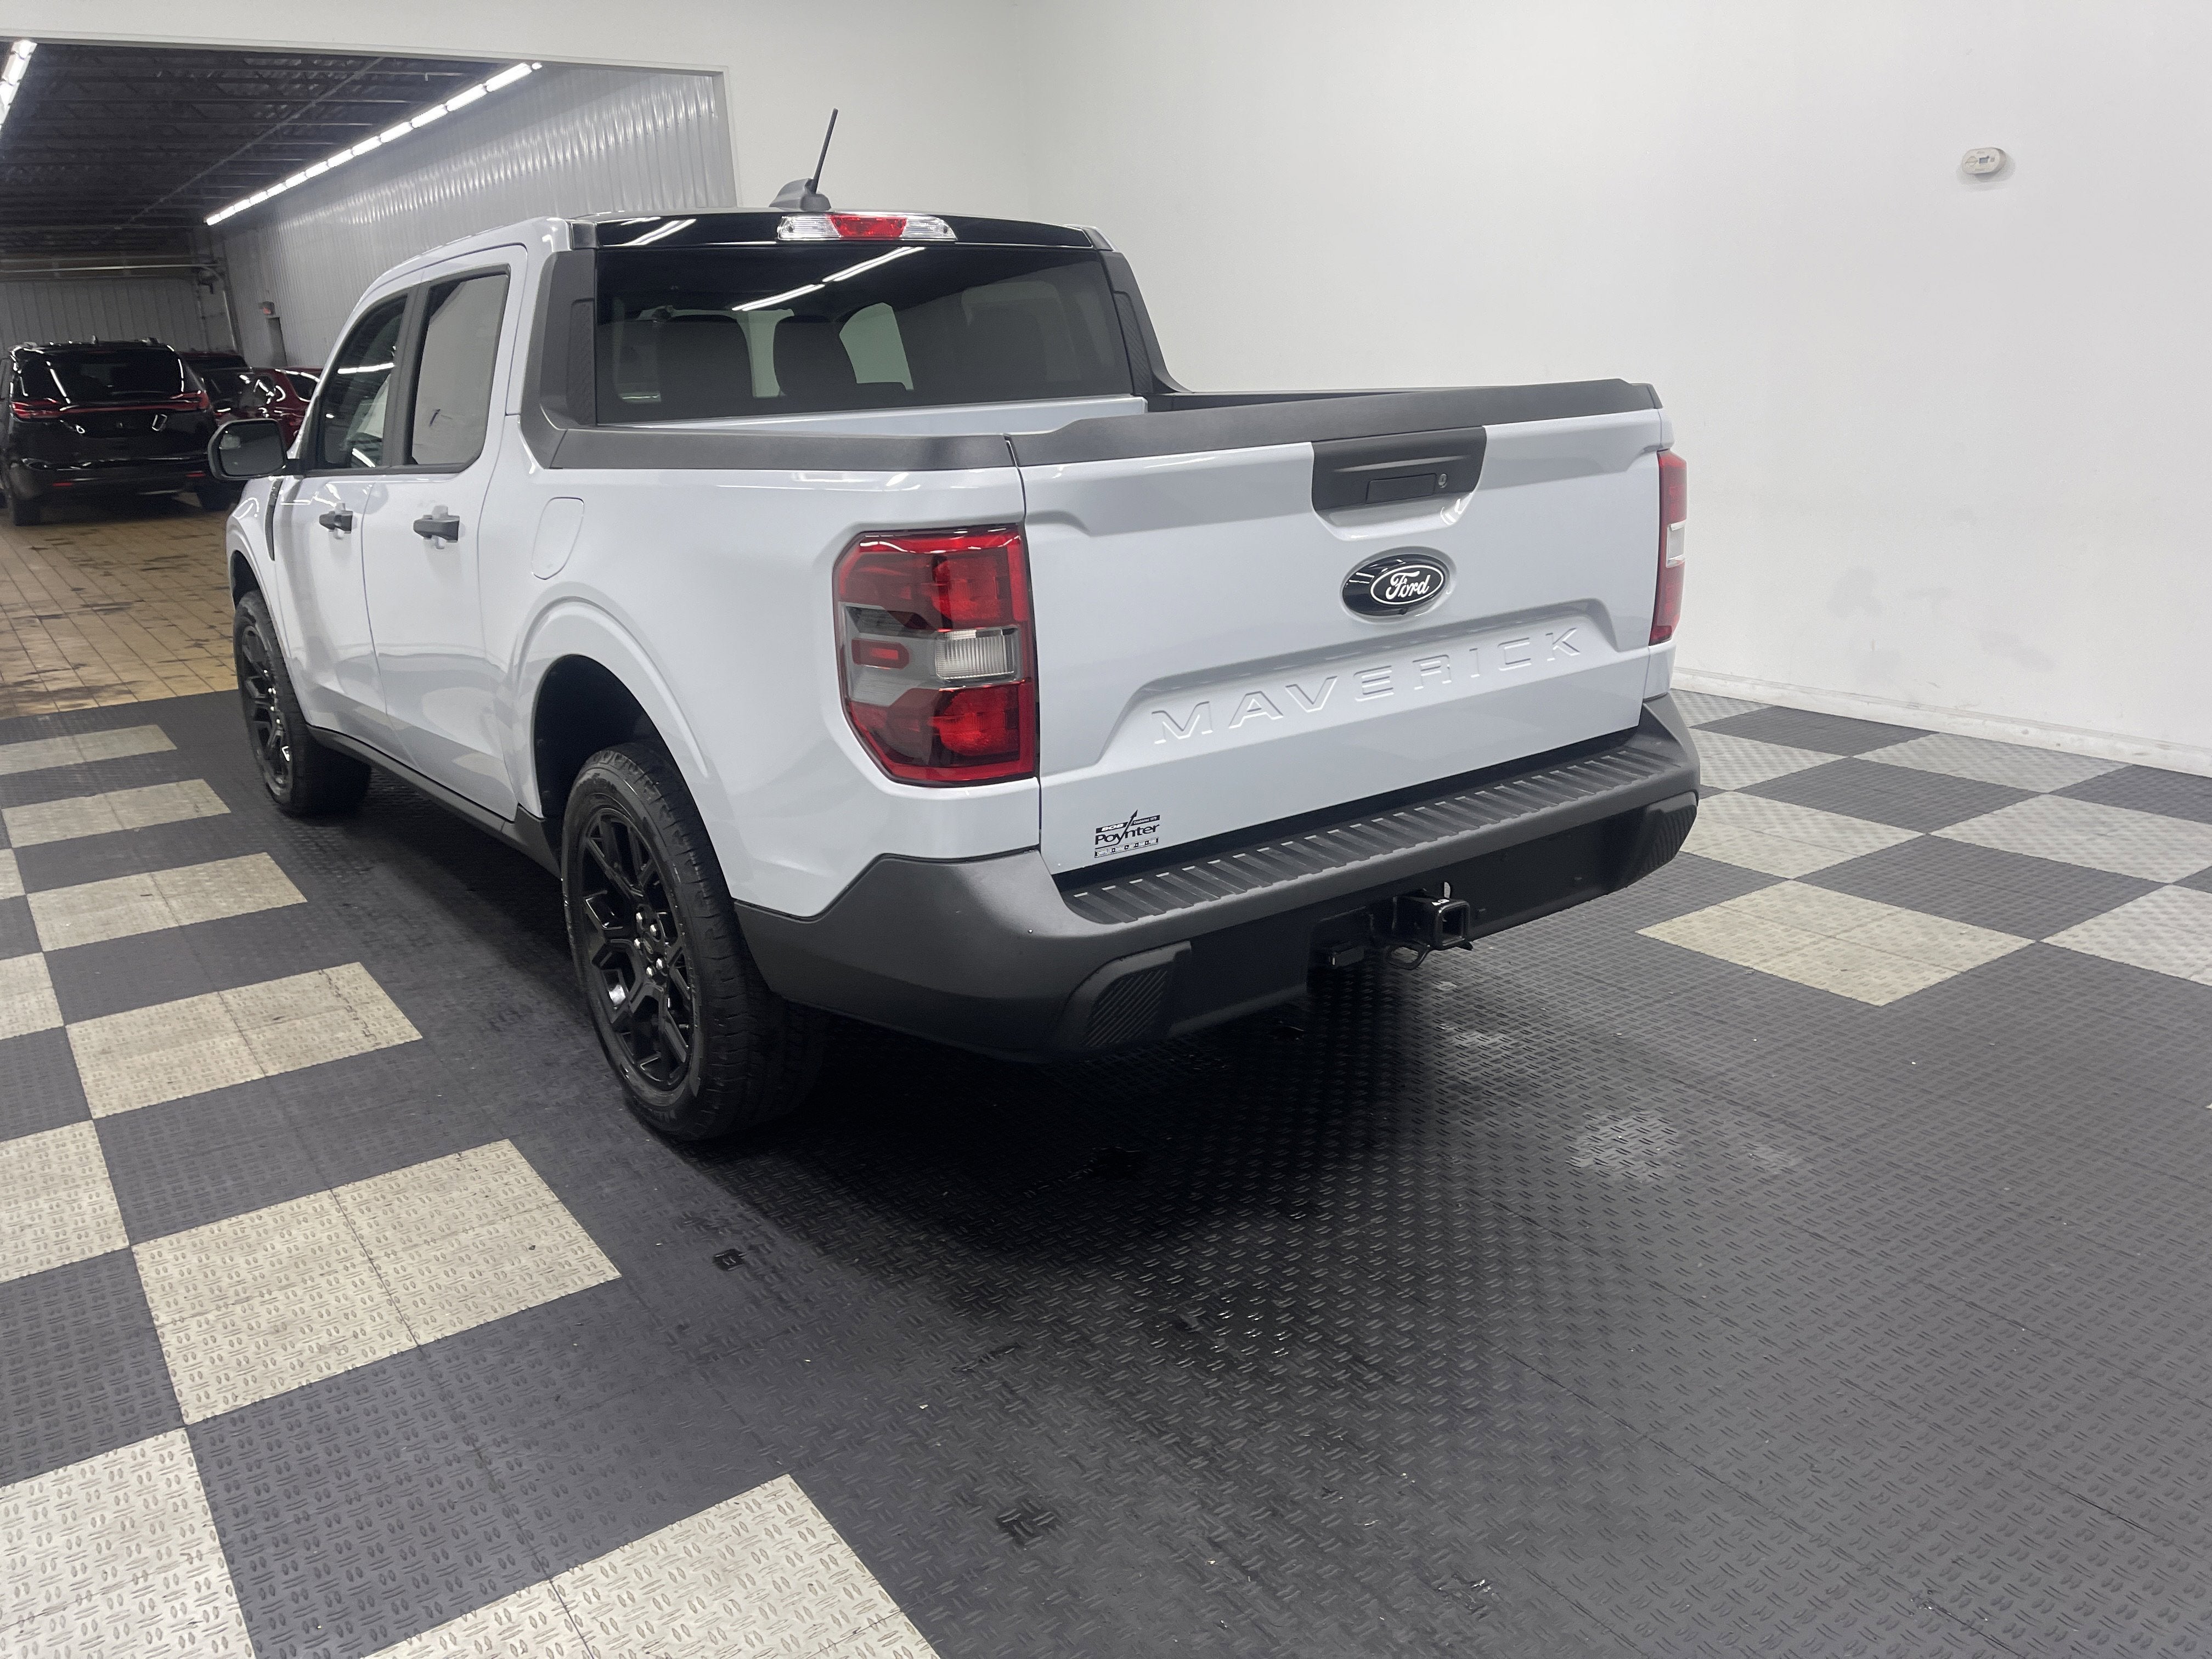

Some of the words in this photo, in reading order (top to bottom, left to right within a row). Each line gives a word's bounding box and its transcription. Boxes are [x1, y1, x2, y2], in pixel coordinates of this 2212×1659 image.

[1385, 571, 1431, 600] Ford
[1152, 628, 1581, 744] MAVERICK
[1094, 824, 1160, 848] Poynter
